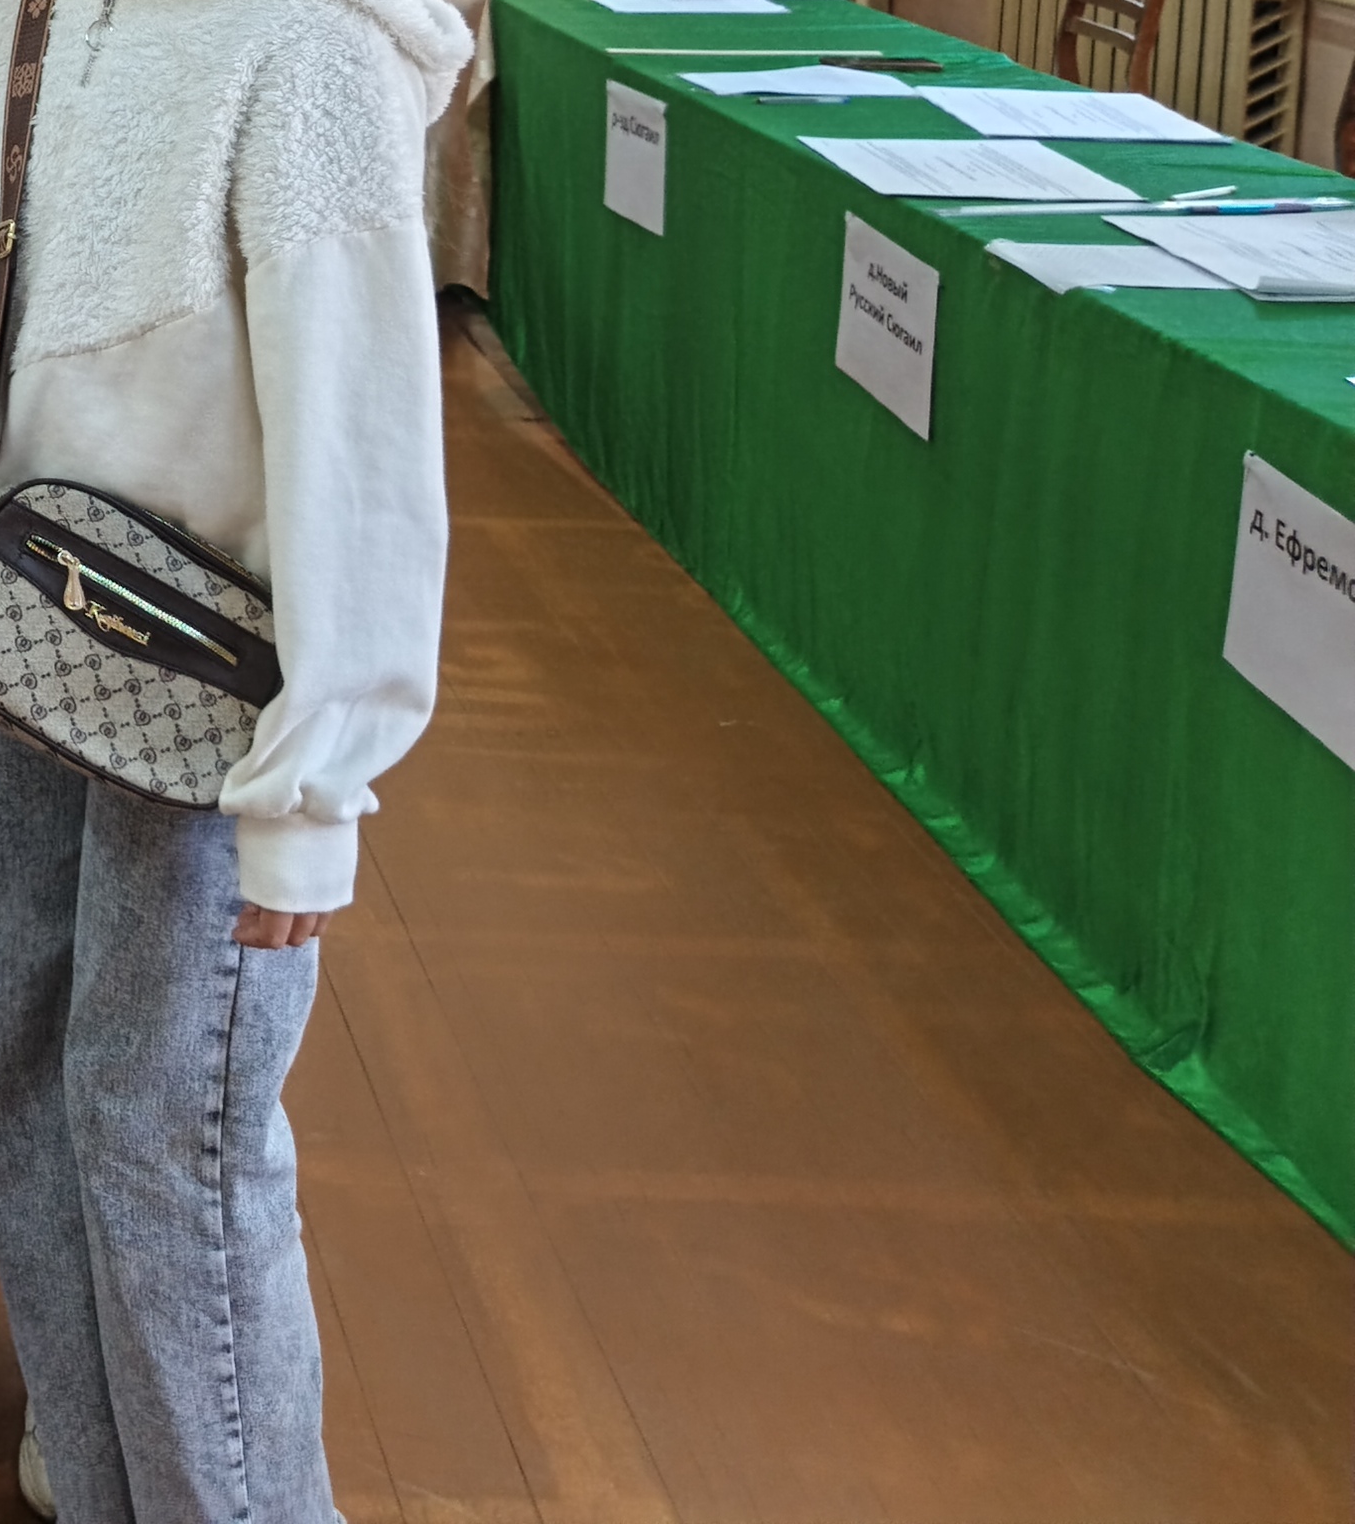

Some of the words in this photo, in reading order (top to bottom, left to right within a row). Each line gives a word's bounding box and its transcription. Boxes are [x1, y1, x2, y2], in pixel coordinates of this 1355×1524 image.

[849, 283, 886, 326] Русский
[887, 314, 923, 355] Сюгаил
[1249, 508, 1270, 542] д.
